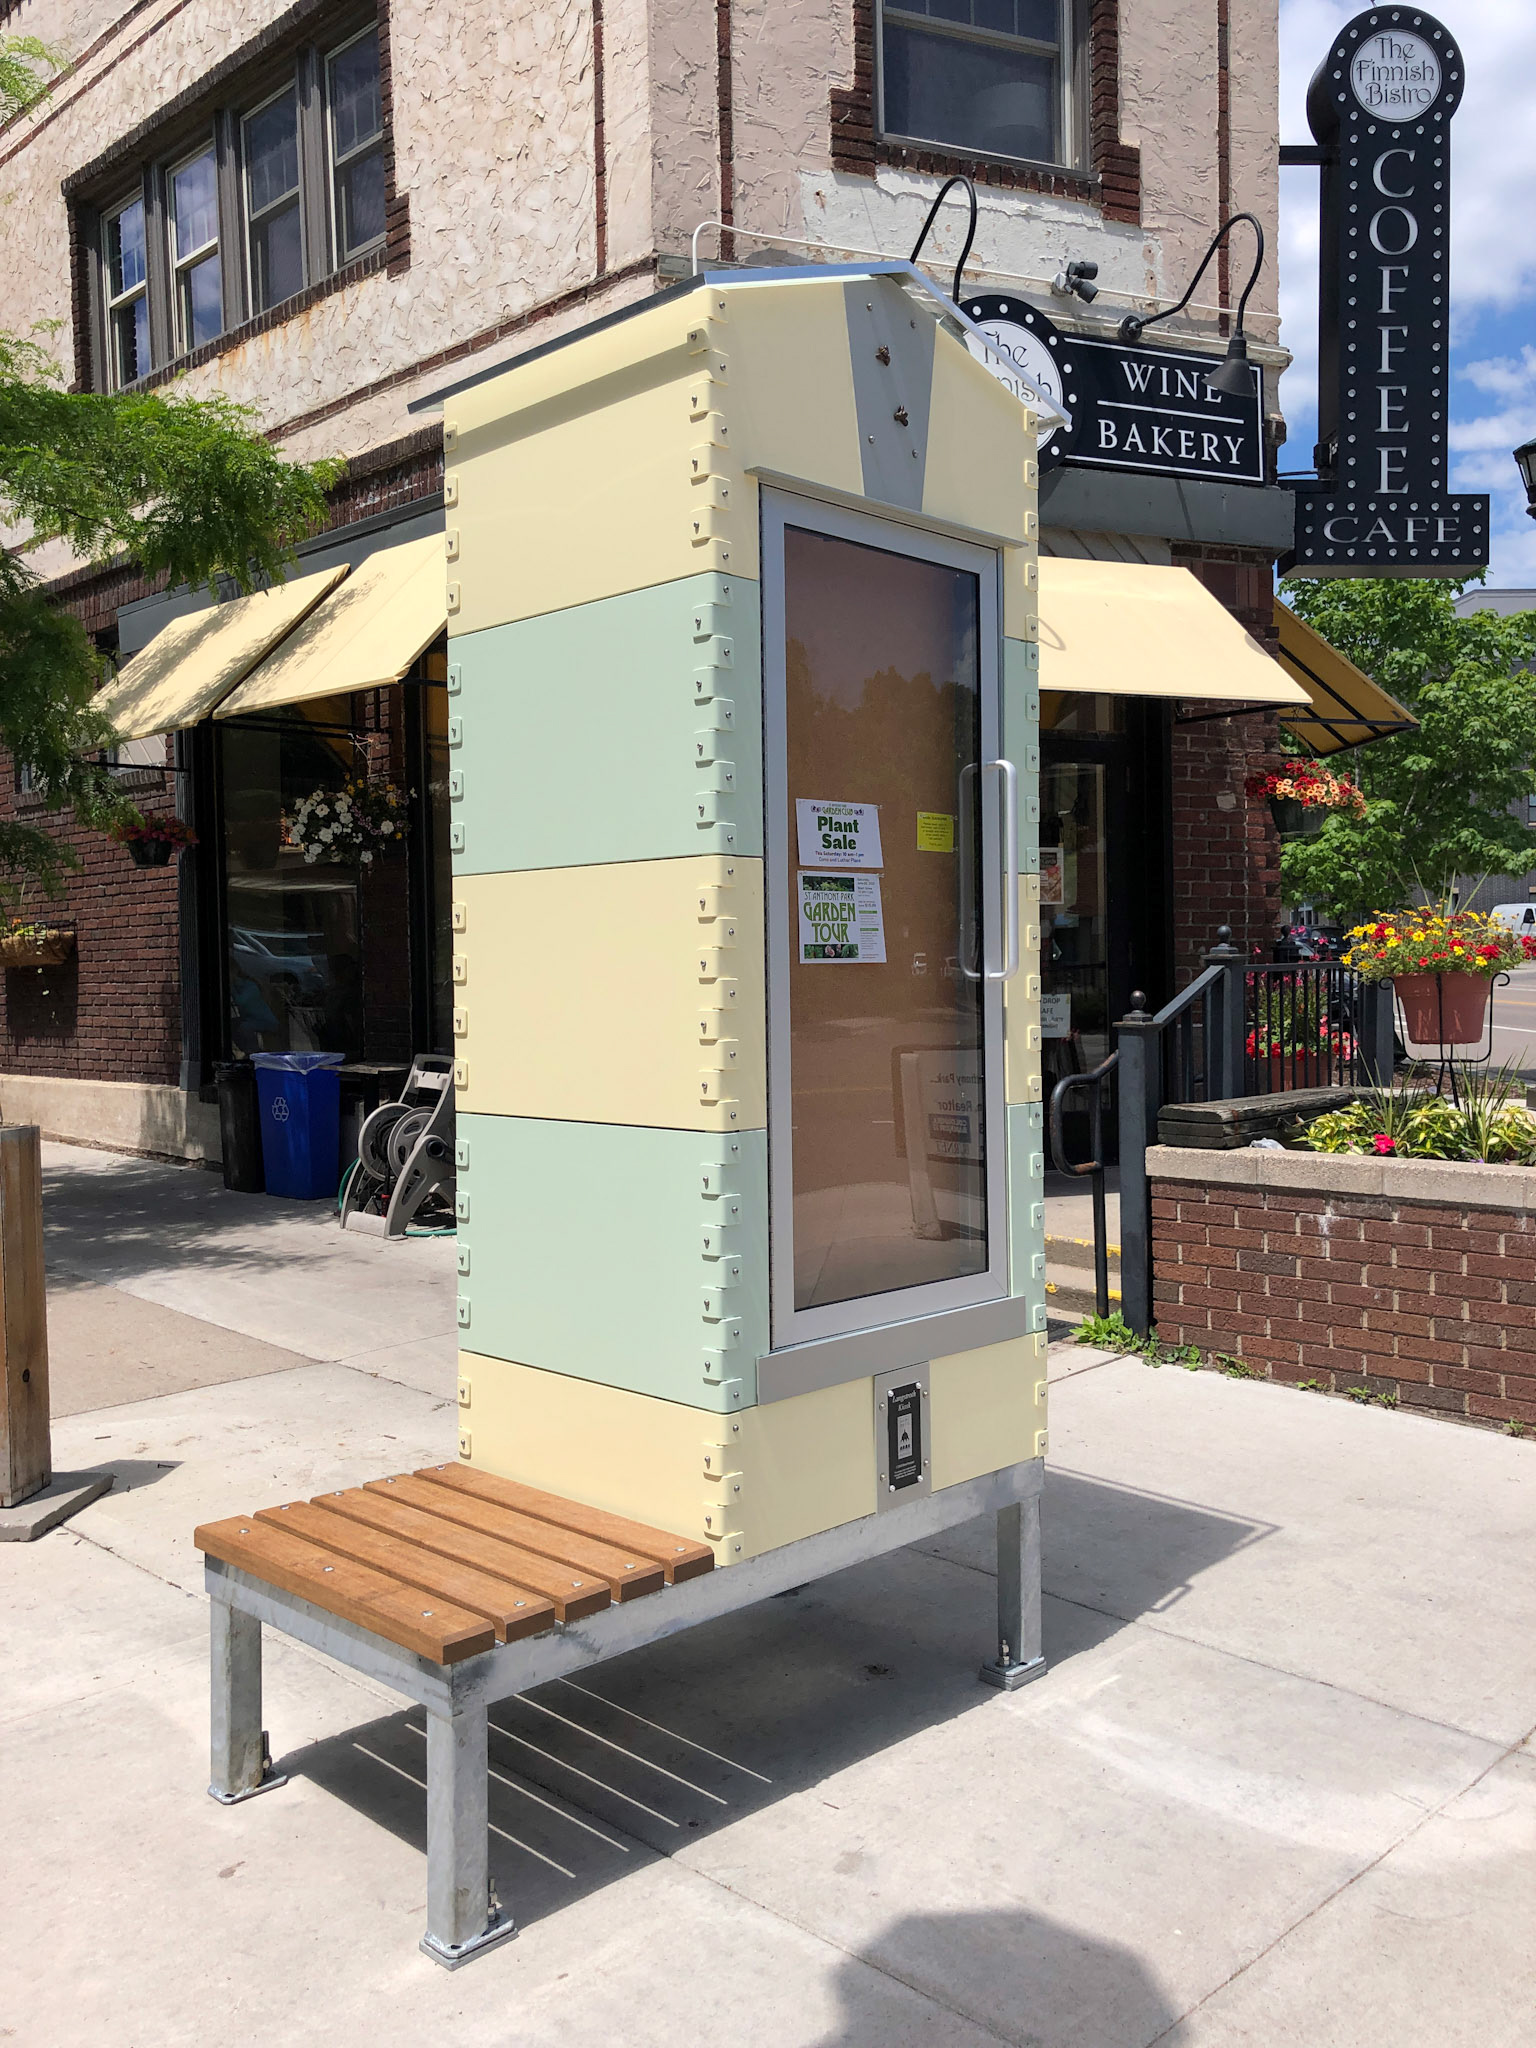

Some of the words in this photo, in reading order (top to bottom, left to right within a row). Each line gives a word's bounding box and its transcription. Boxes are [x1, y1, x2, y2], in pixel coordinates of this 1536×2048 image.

[1375, 36, 1416, 61] The
[1356, 59, 1434, 81] Finnish
[1365, 82, 1431, 106] Bistro
[1369, 148, 1418, 495] COFFEE
[1097, 418, 1245, 465] BAKERY
[1323, 516, 1461, 543] CAFE
[821, 806, 841, 816] GARDEN
[817, 815, 860, 834] Plant
[821, 833, 857, 850] Sale
[840, 892, 855, 902] PARK
[803, 901, 856, 922] GARDEN
[811, 922, 850, 943] TOUR
